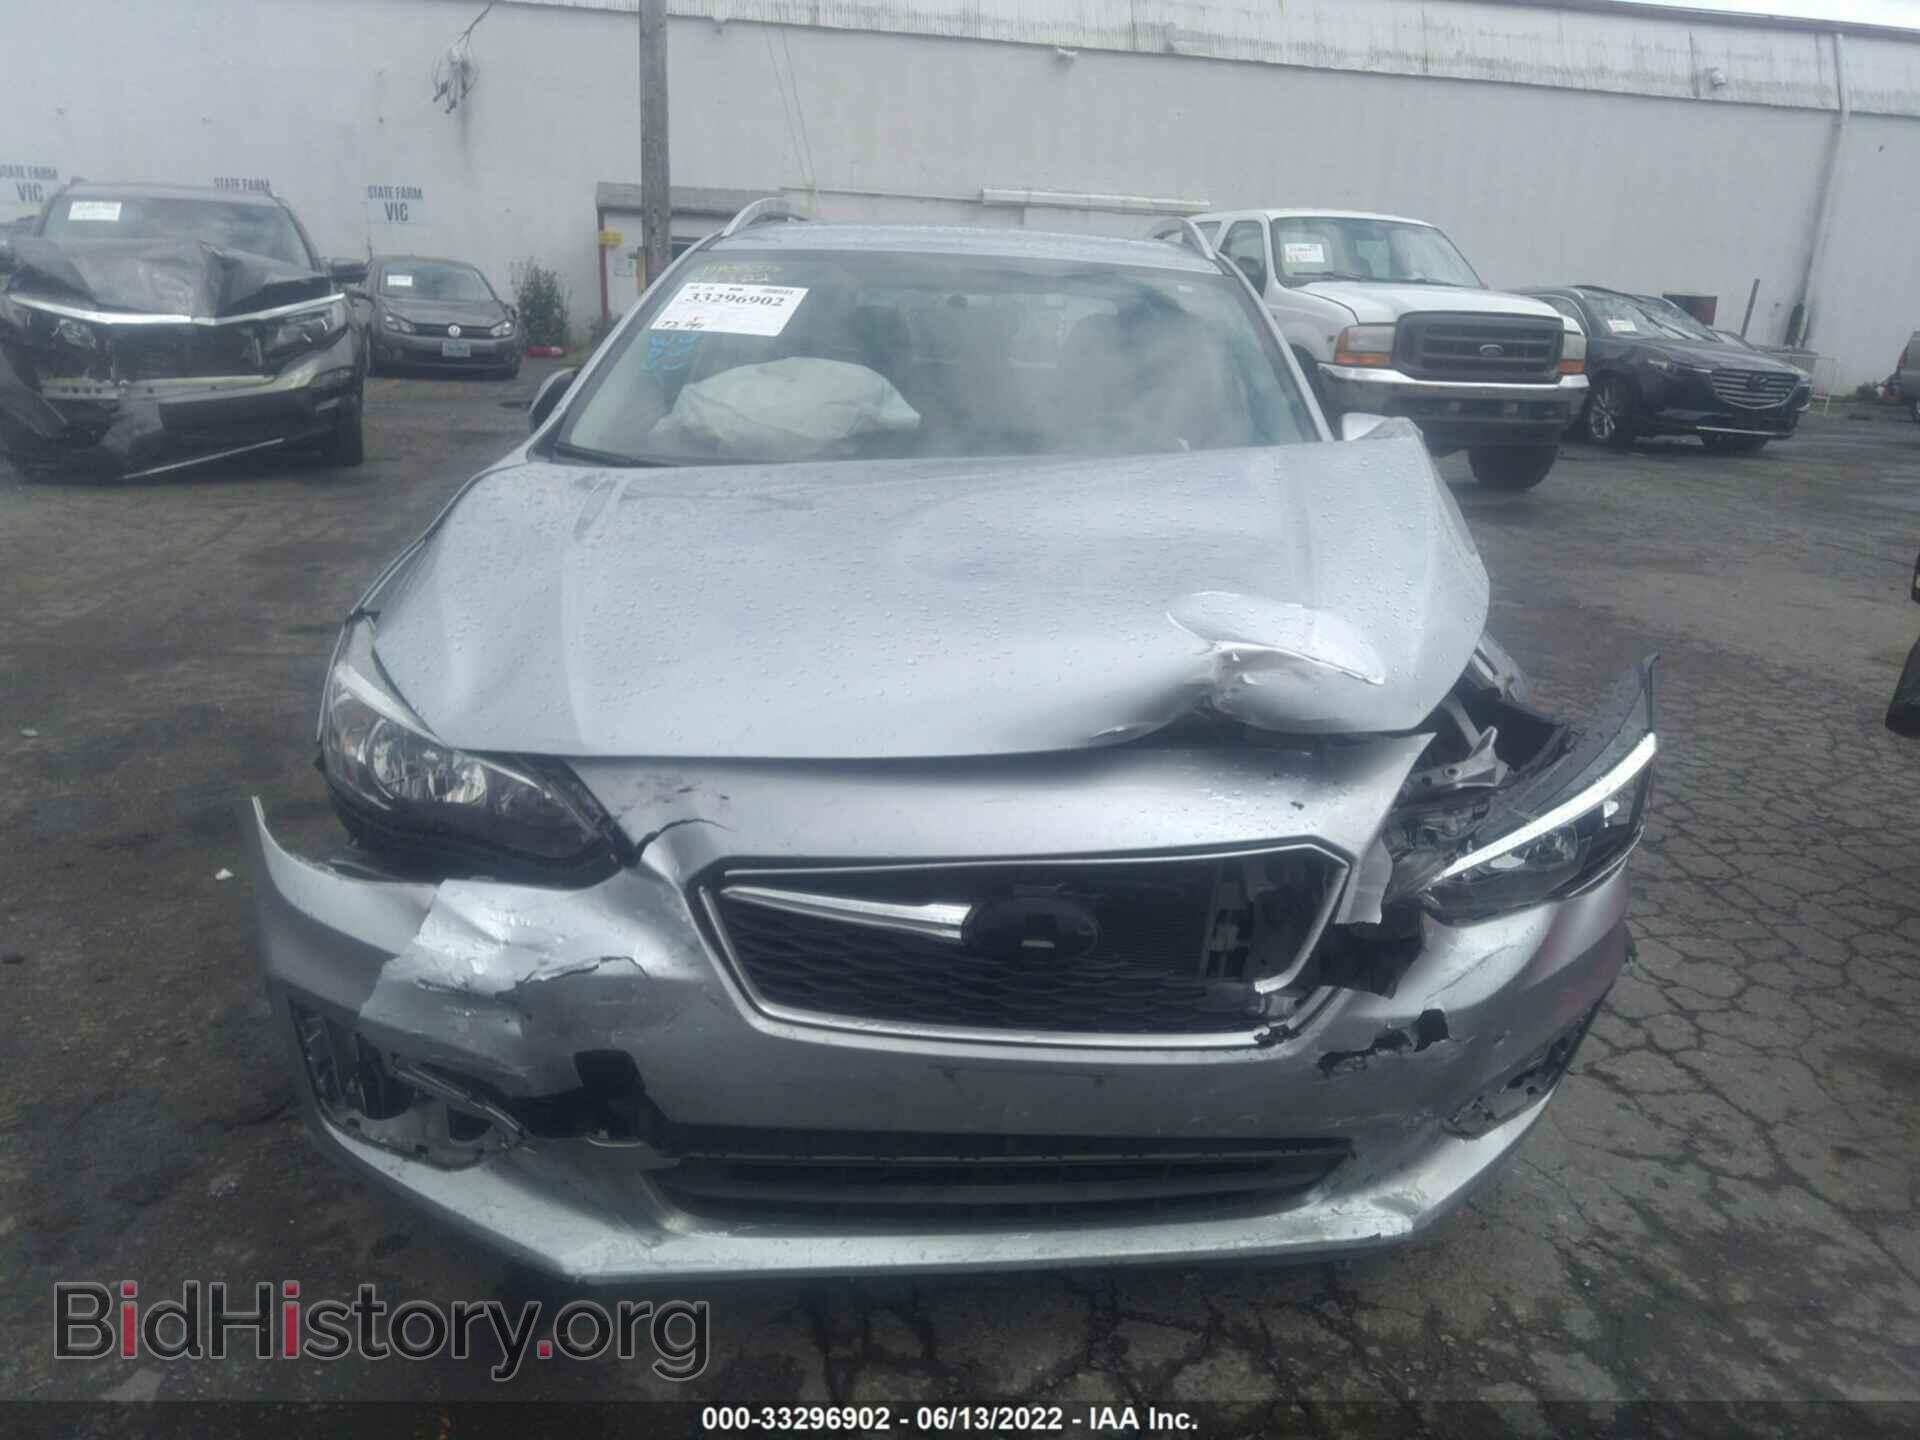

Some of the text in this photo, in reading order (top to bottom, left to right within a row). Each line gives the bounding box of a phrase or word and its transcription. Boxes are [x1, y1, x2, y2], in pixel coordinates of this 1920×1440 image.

[16, 182, 44, 203] VIC
[367, 184, 423, 200] STATE FARM
[384, 201, 408, 222] VIC
[686, 292, 785, 307] 33296902
